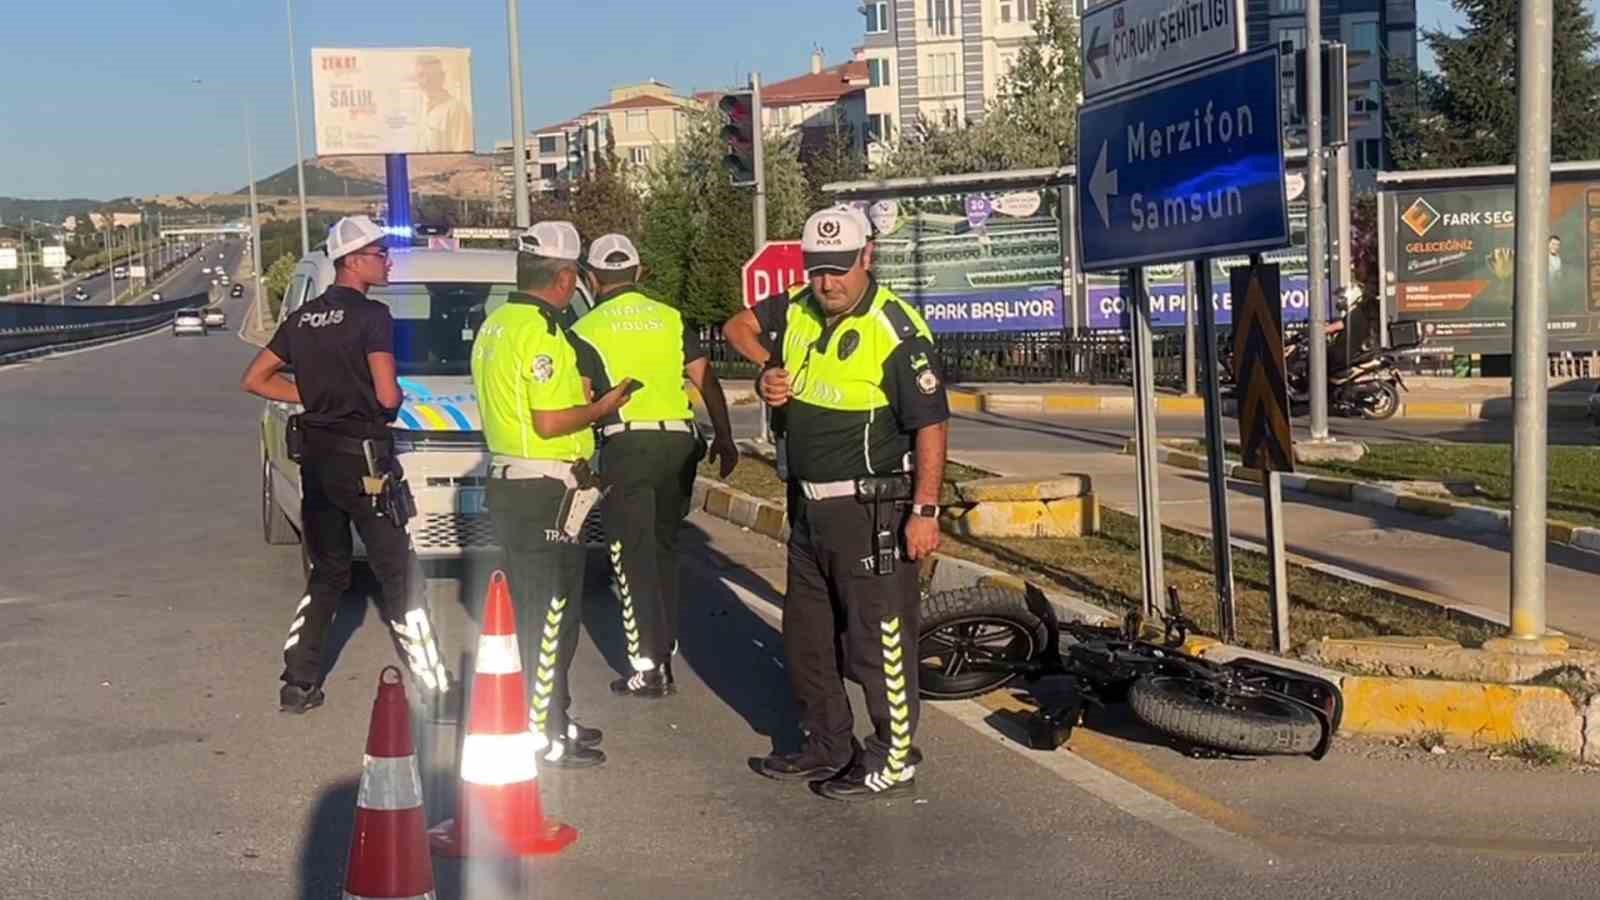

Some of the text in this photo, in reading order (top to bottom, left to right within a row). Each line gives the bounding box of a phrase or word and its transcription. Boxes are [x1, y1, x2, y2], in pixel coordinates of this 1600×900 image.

[1113, 19, 1156, 67] ÇORUM
[1127, 100, 1253, 163] Merzifon
[1130, 185, 1243, 232] Samsun
[1443, 212, 1480, 226] FARK
[753, 268, 808, 301] DU
[924, 300, 1055, 323] PARK BAŞLIYOR
[1099, 294, 1165, 319] ÇOM
